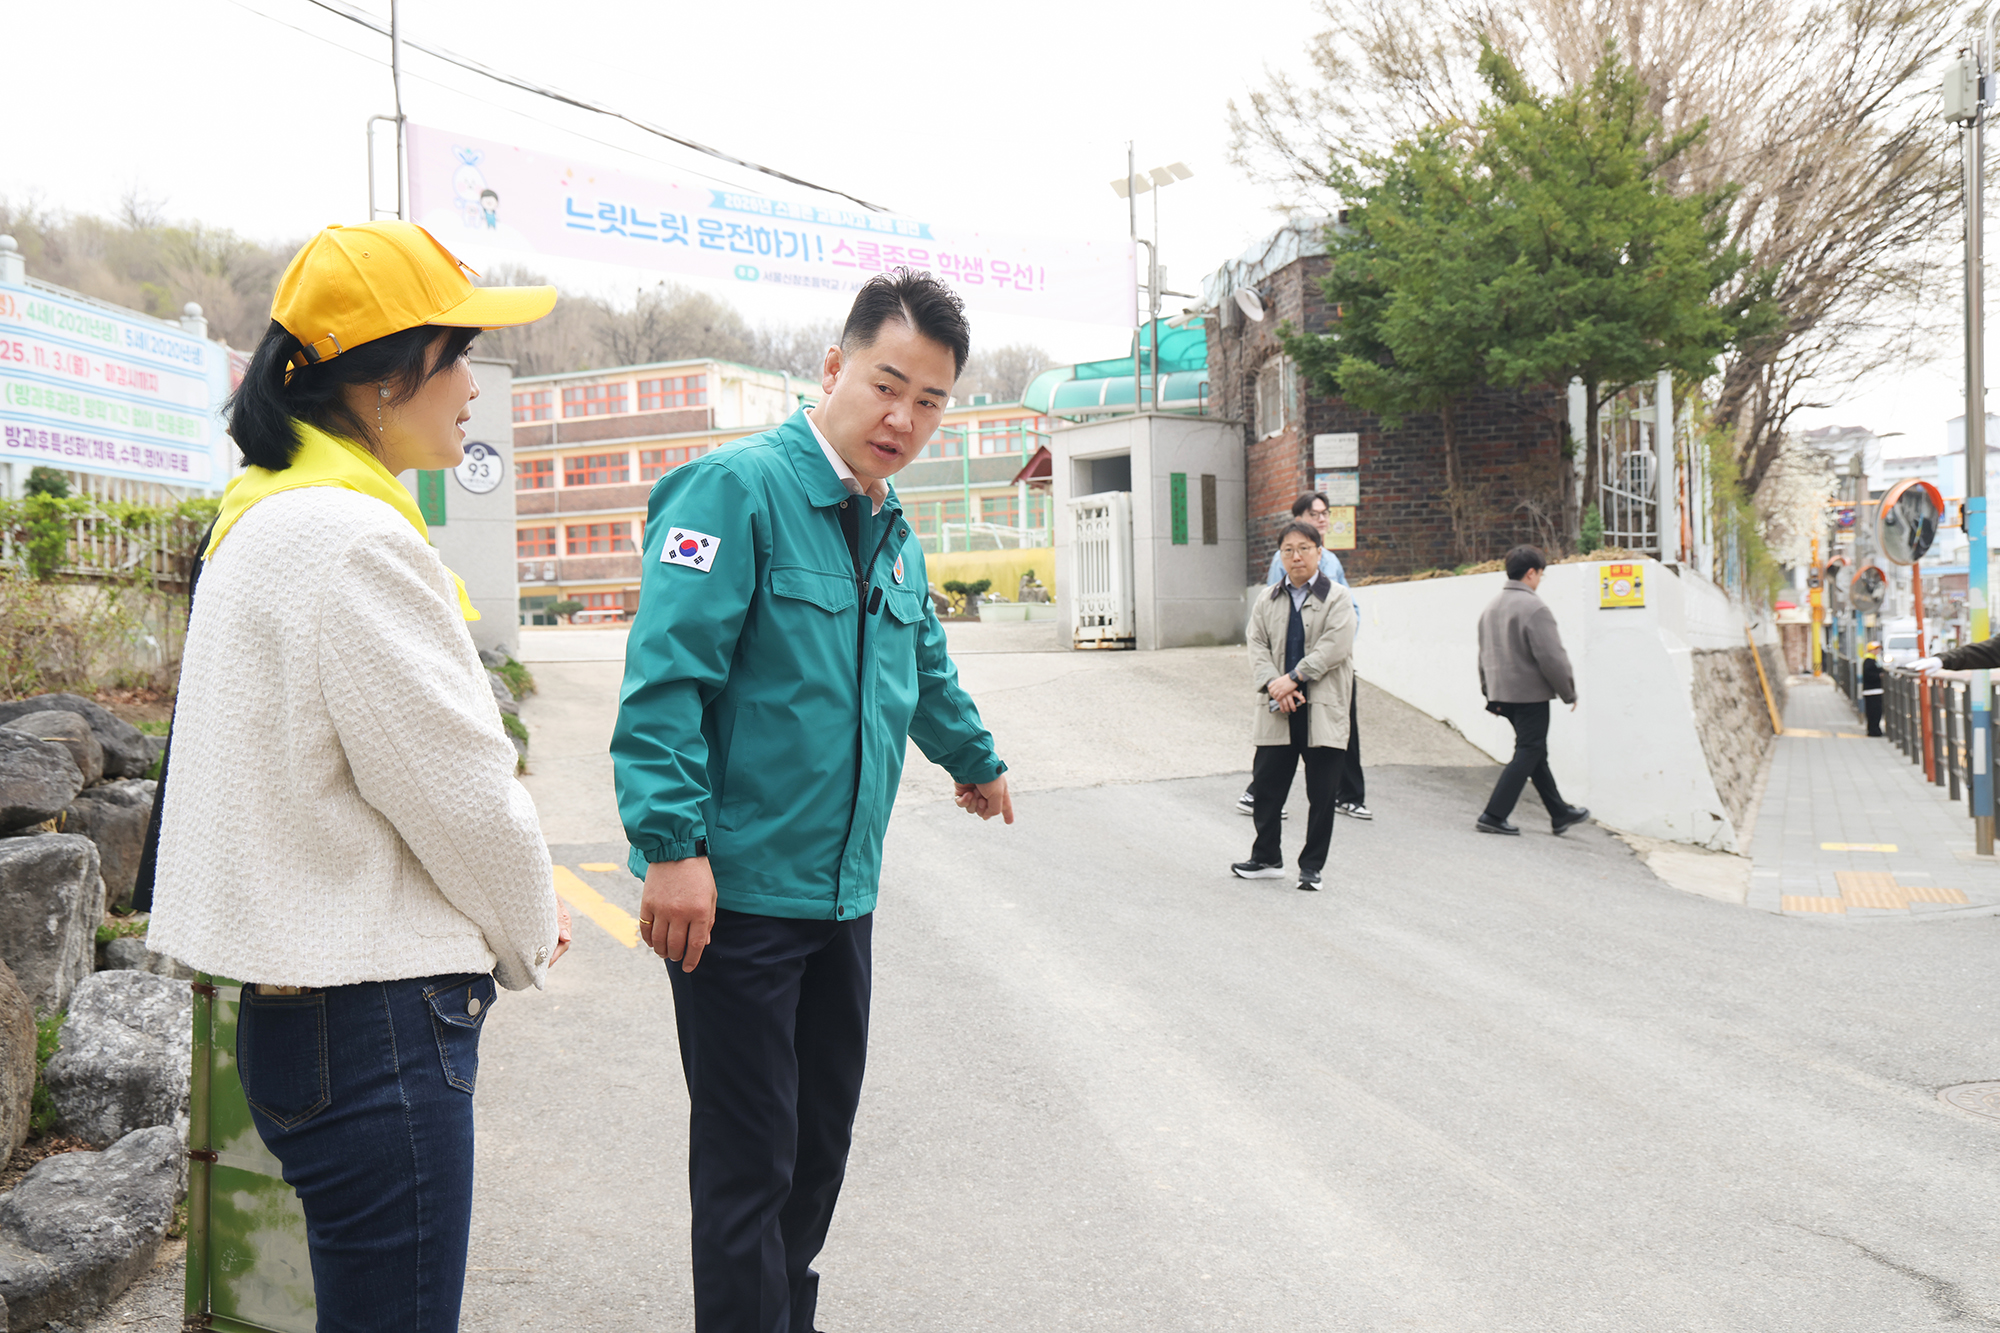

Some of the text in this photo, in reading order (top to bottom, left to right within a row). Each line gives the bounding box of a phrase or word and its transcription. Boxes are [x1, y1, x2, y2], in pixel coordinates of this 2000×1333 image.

[566, 197, 689, 246] 느릿느릿
[936, 252, 984, 285] 학생
[468, 462, 490, 478] 93
